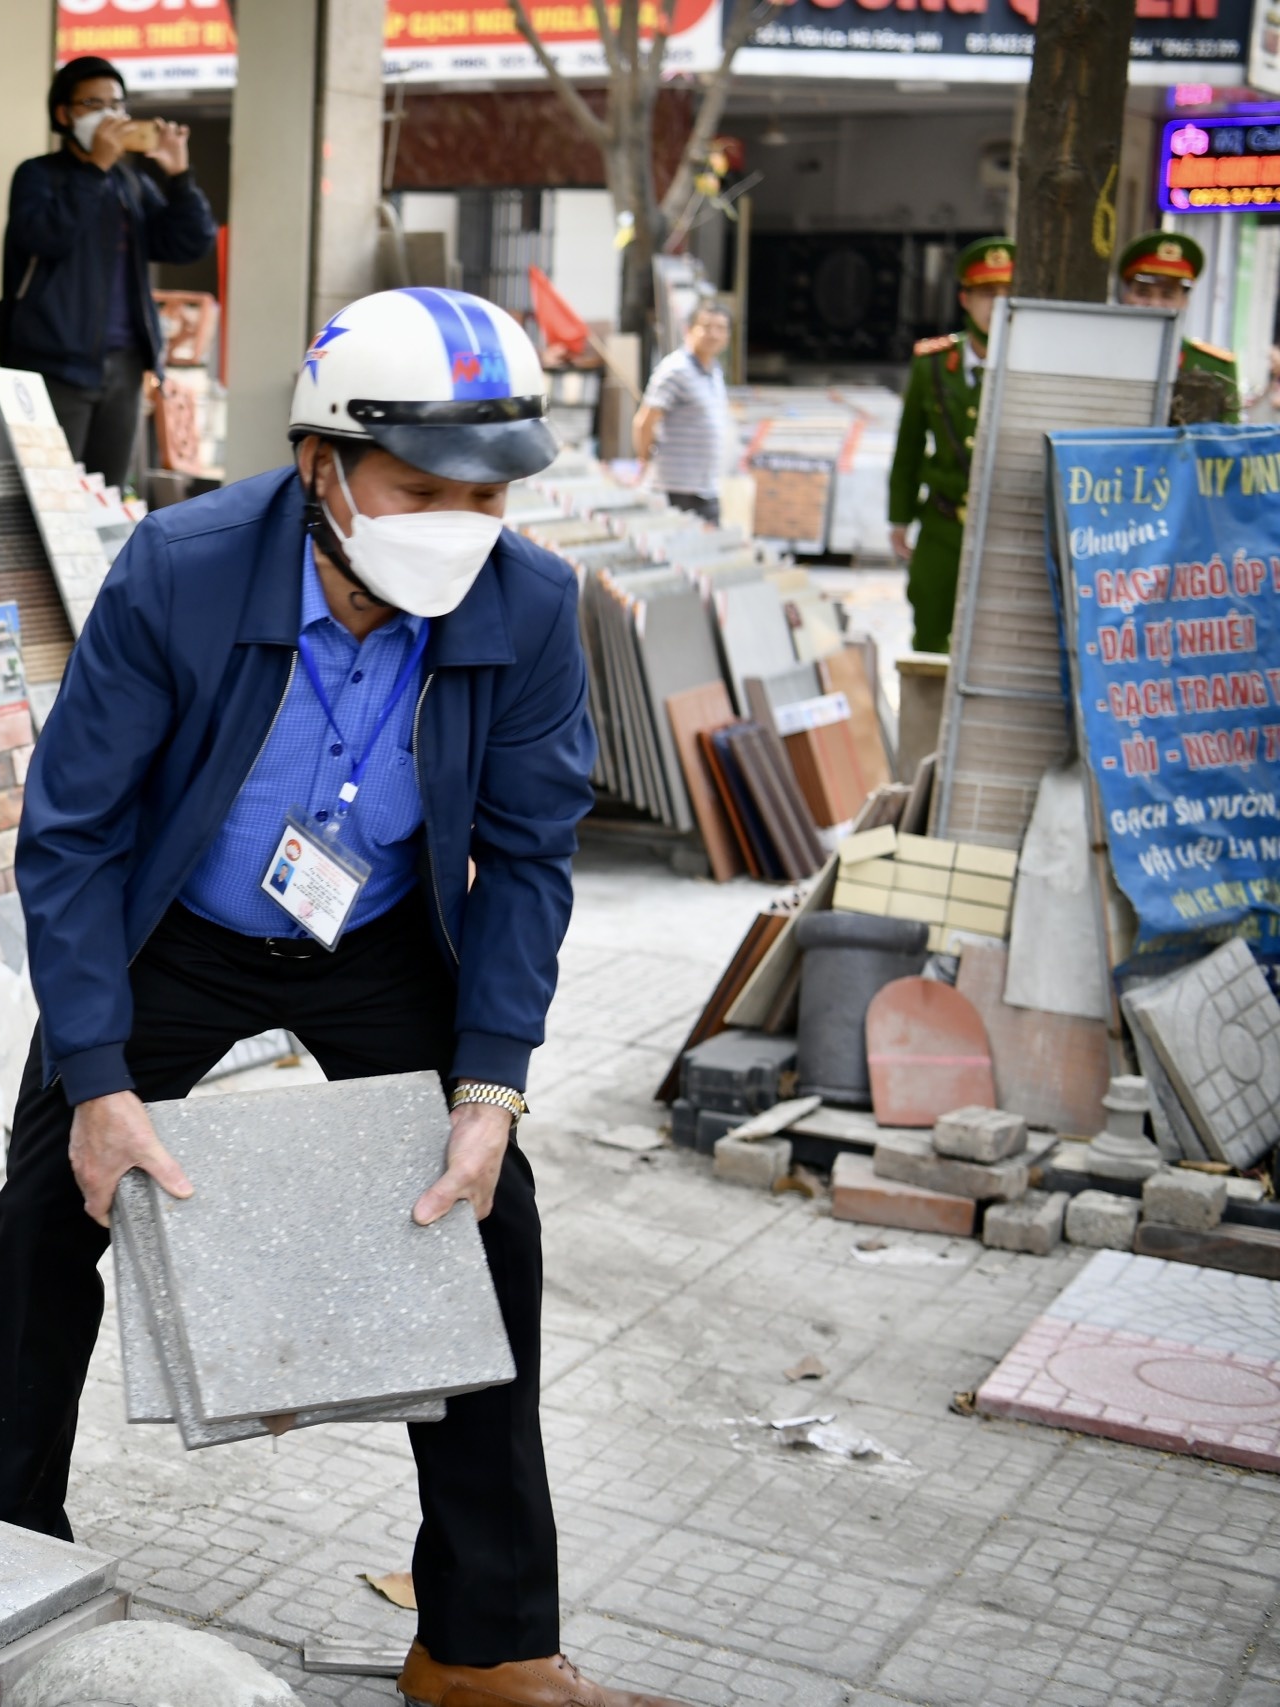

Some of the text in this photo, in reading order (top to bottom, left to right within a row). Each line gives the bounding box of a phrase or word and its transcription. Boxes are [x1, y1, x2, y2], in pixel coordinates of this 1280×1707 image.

[1068, 465, 1123, 517] Đại
[1095, 564, 1170, 613] GẠCH
[1108, 678, 1178, 727] GẠCH
[1178, 670, 1269, 714] TRANG
[1181, 727, 1259, 773] NGOẠI
[1110, 804, 1169, 838] GẠCH
